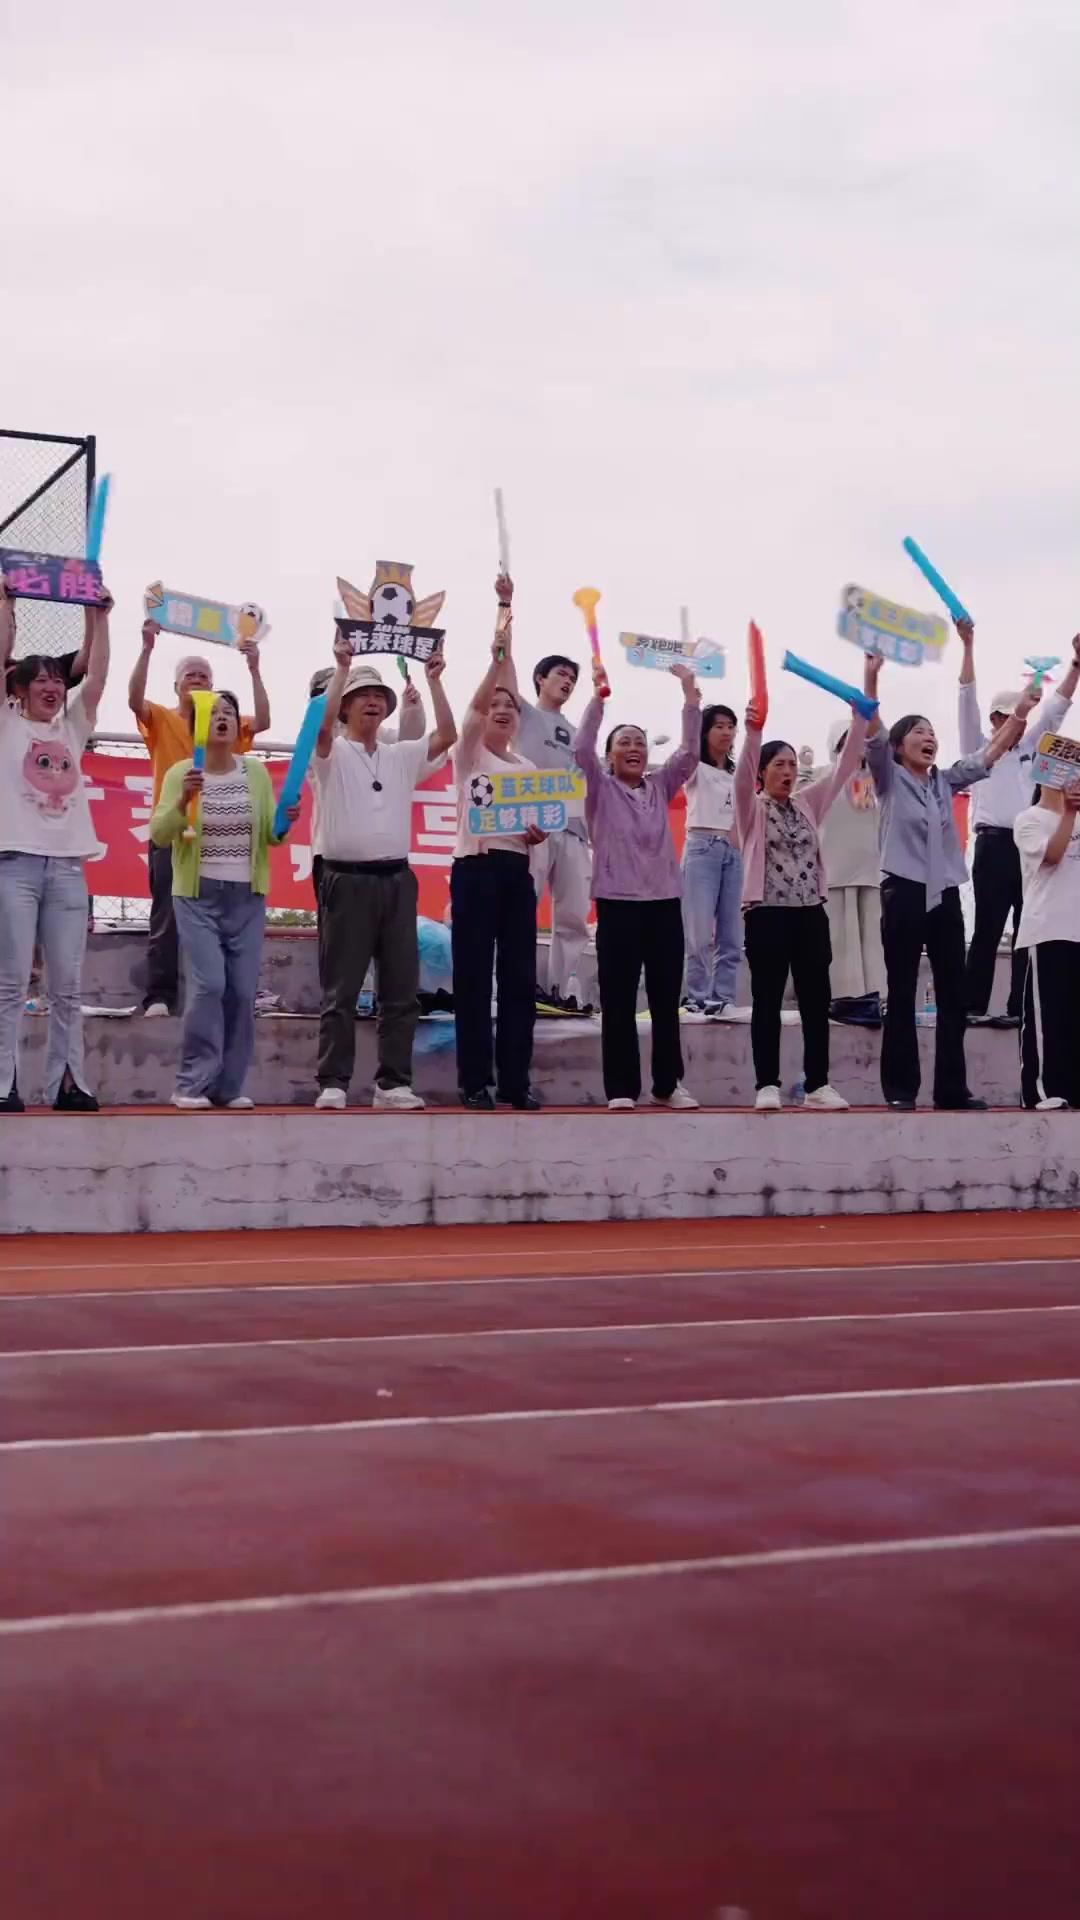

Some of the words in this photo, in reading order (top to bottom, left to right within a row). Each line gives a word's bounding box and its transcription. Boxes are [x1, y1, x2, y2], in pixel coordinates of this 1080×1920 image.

[349, 629, 435, 660] 未来球星
[501, 775, 575, 798] 蓝天球队
[479, 804, 562, 832] 足够精彩
